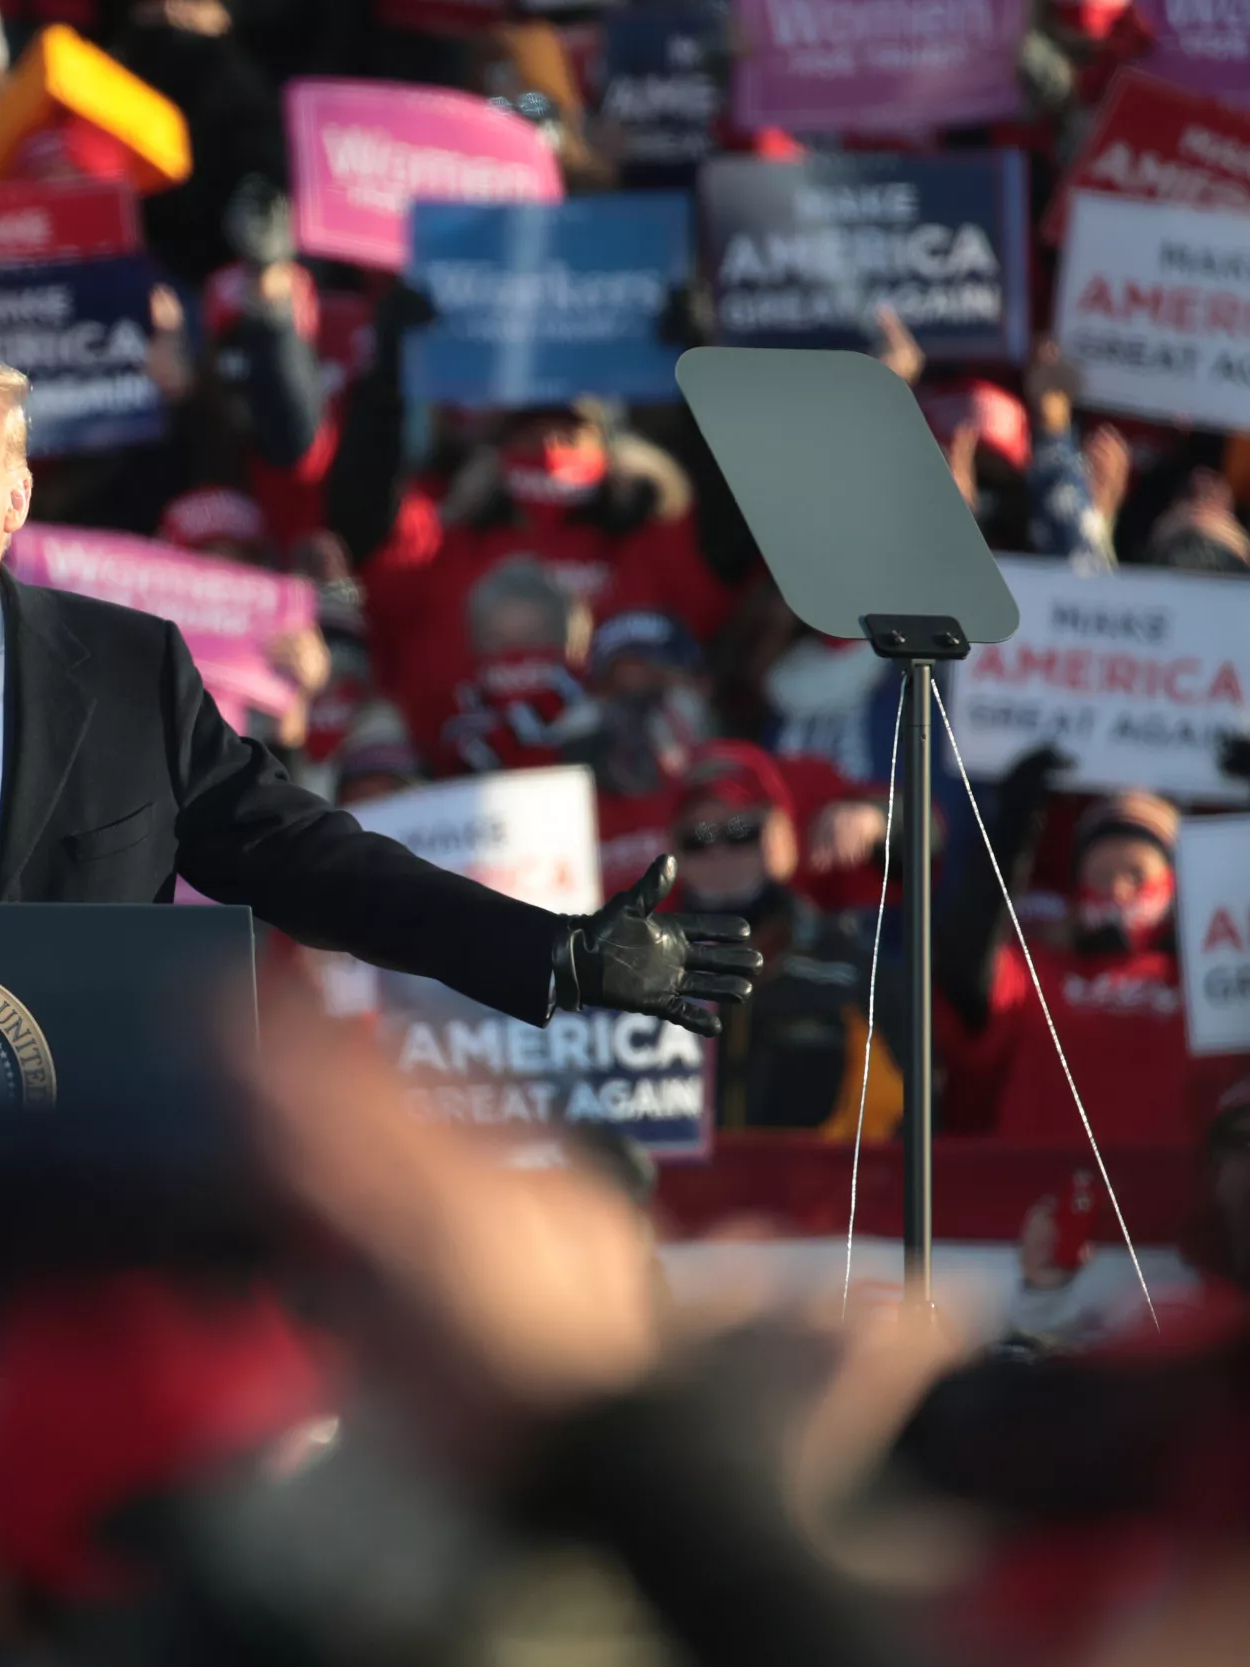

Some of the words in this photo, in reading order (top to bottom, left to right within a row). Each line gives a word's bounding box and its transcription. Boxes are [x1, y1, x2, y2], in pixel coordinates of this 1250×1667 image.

[718, 222, 1000, 286] AMERICA
[1052, 601, 1173, 643] MAKE
[972, 643, 1246, 708] AMERICA
[399, 1012, 704, 1077] AMERICA
[564, 1075, 704, 1122] AGAIN
